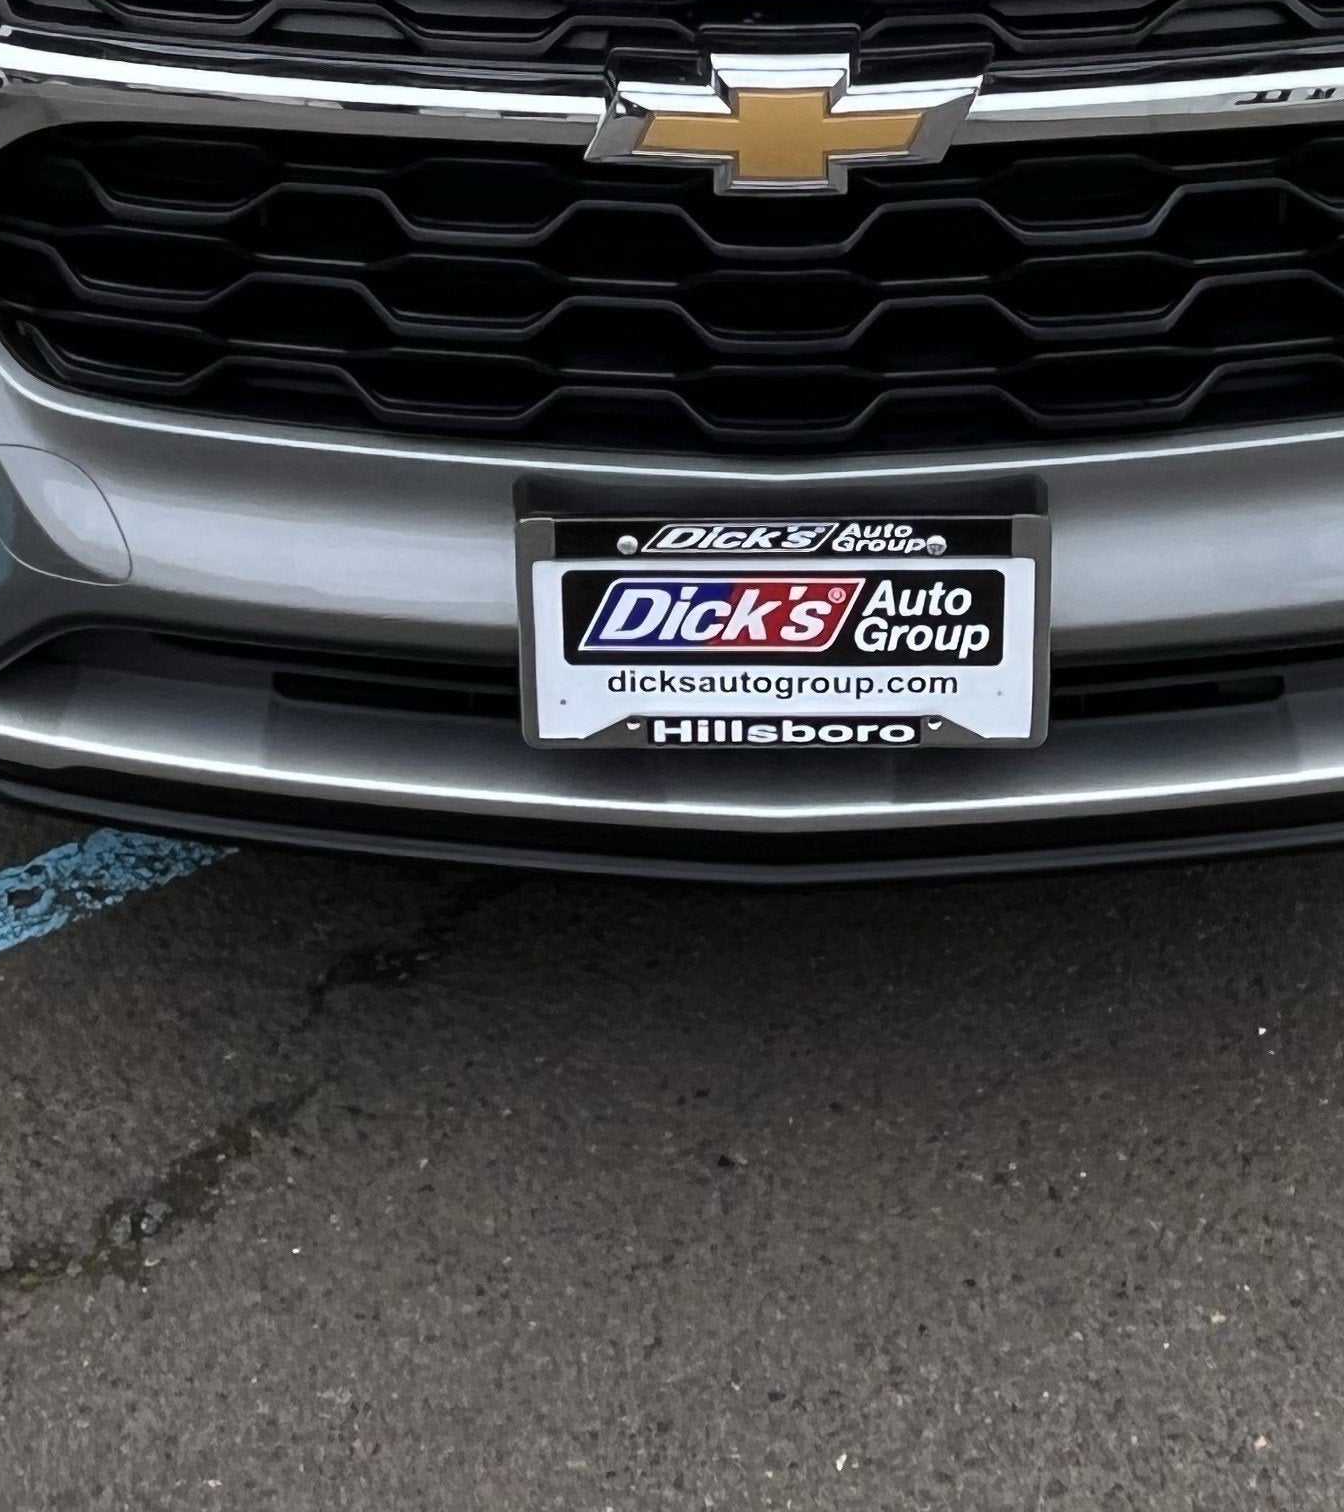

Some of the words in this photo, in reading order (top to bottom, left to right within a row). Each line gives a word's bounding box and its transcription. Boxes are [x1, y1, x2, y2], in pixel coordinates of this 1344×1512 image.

[654, 524, 826, 551] Dick's
[838, 522, 913, 539] Auto
[832, 535, 927, 554] Group
[861, 580, 973, 618] Auto
[855, 617, 991, 659] Group
[606, 670, 958, 700] dicksautogroup.com
[652, 718, 916, 744] Hillsboro
